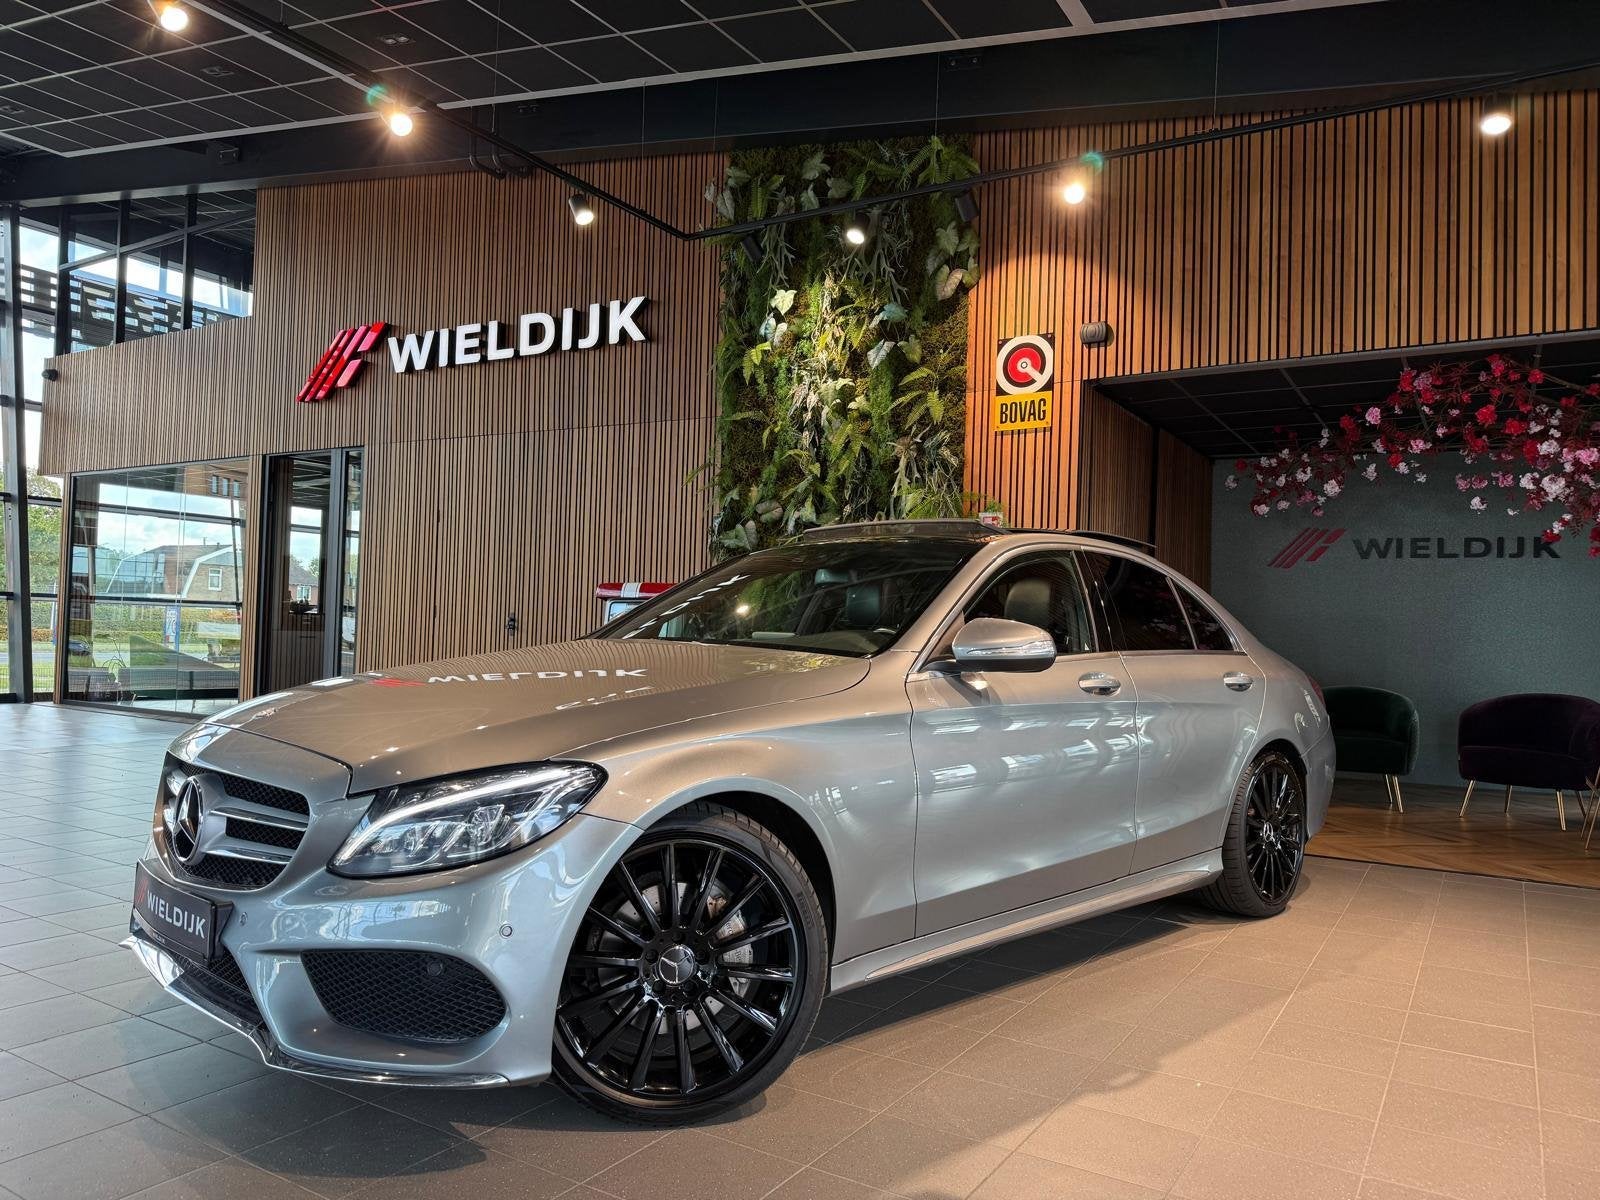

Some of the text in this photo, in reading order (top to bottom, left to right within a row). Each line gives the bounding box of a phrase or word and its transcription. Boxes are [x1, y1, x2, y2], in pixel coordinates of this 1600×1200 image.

[387, 296, 647, 373] WIELDIJK
[1000, 398, 1047, 424] BOVAG
[1352, 536, 1560, 559] WIELDIJK
[147, 889, 206, 939] WIELDIJK
